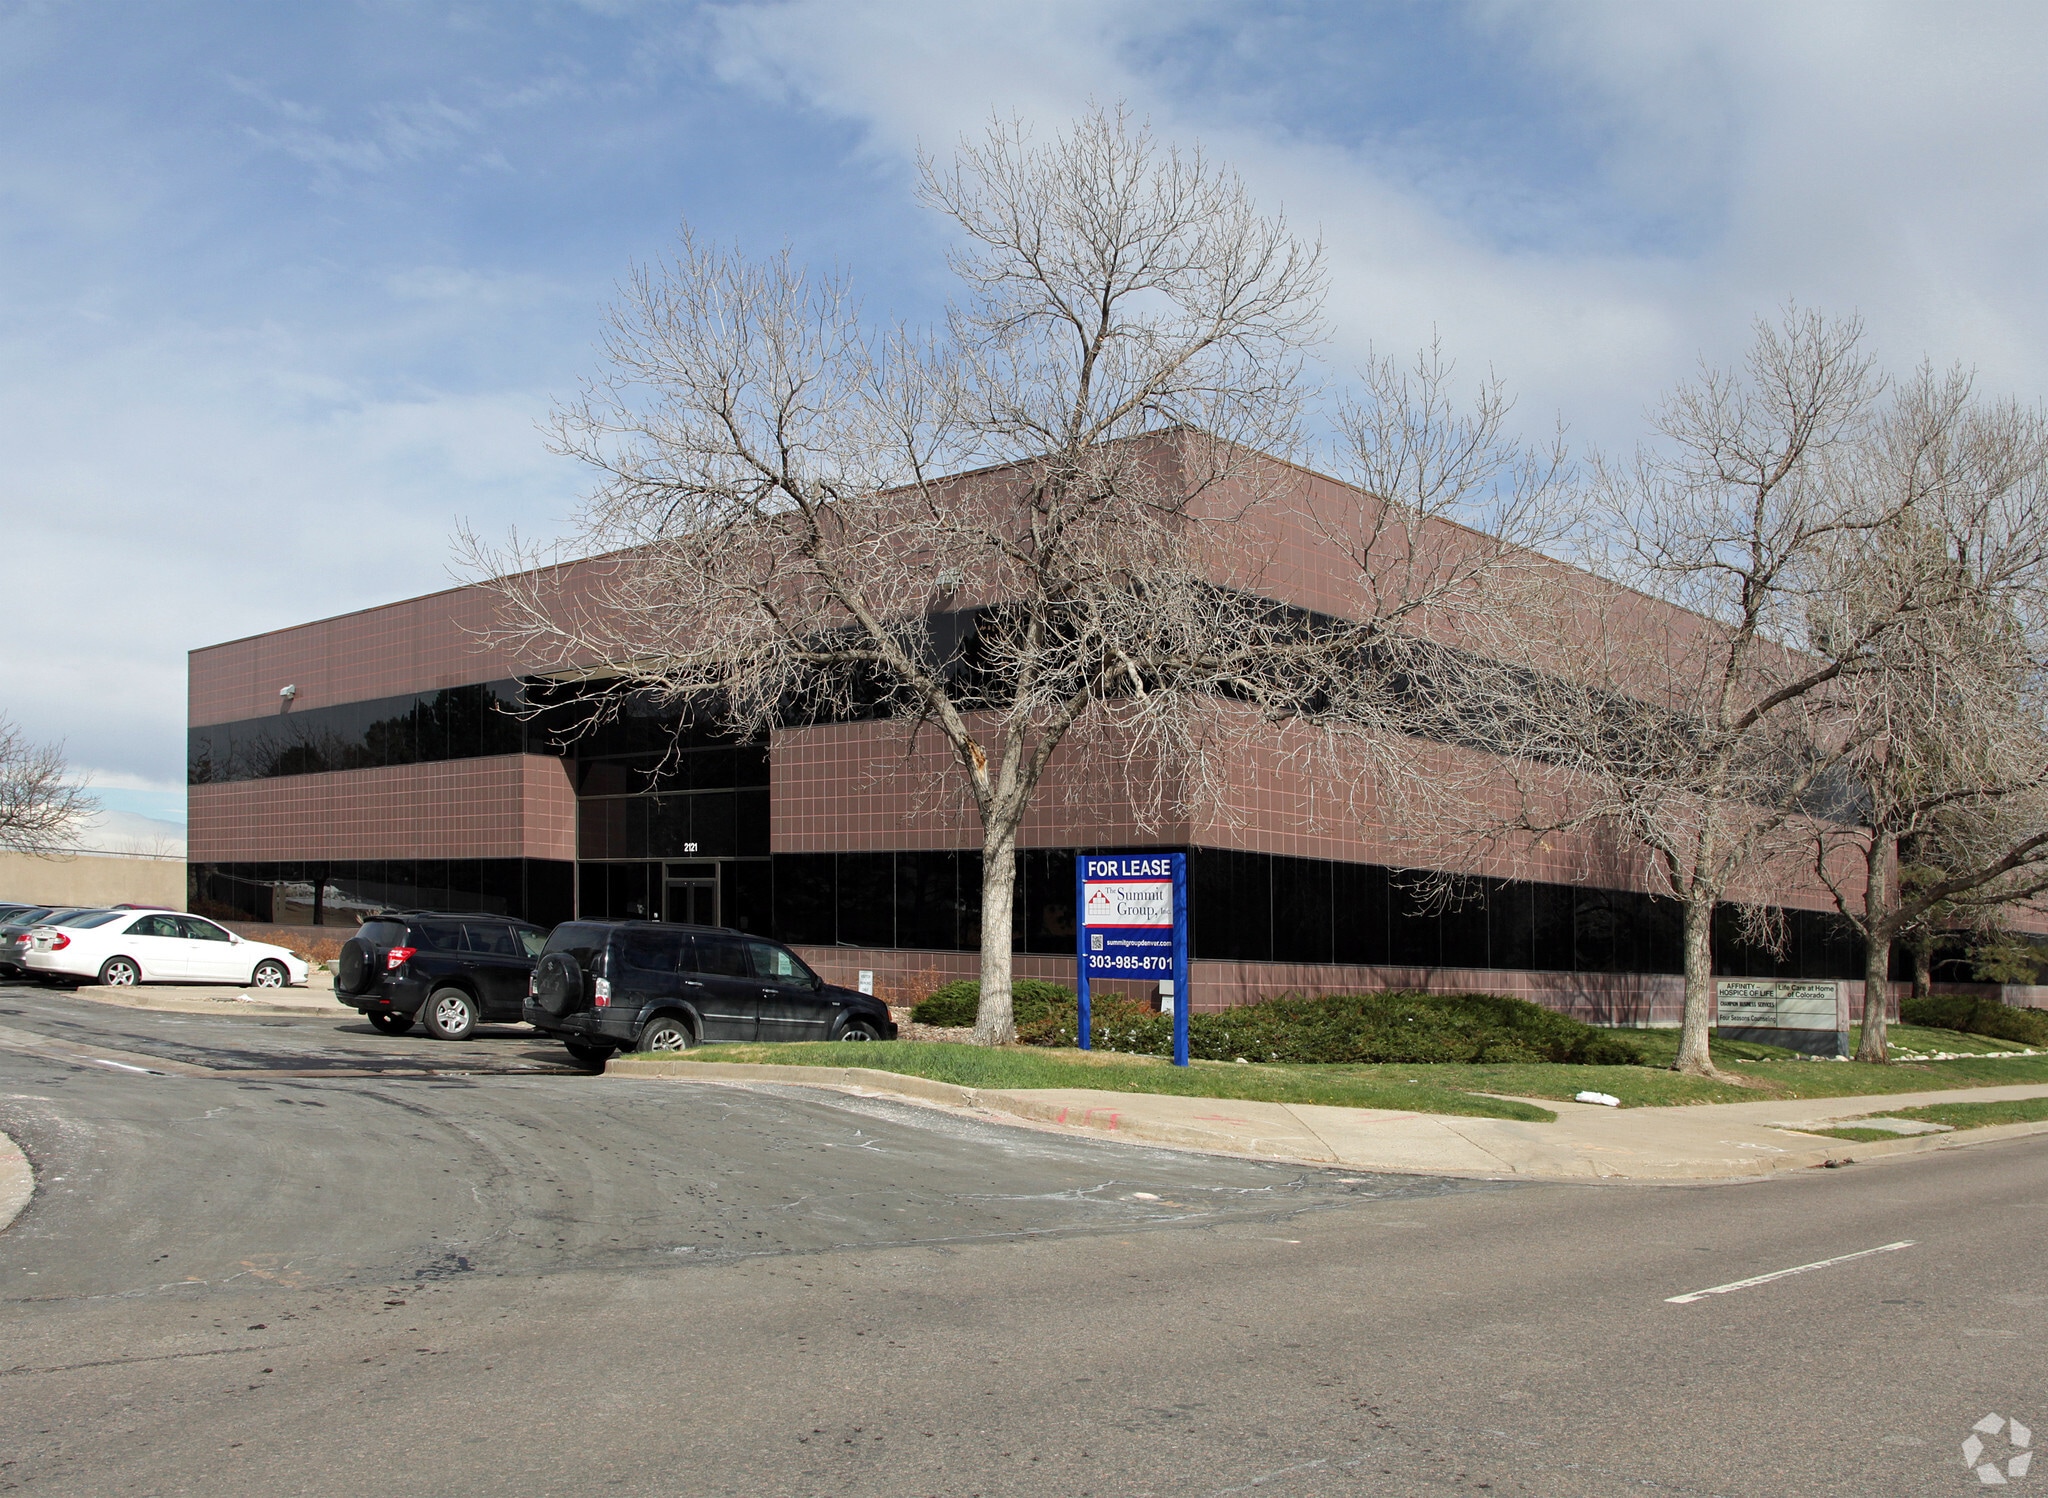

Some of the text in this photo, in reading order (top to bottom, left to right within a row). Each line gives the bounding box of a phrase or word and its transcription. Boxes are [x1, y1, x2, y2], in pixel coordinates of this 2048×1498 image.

[684, 842, 698, 852] 2121
[1088, 859, 1171, 877] FOR LEASE
[1117, 886, 1164, 901] Summit
[1117, 902, 1158, 920] Group,
[1106, 939, 1172, 947] summitgroupdenver.com
[1089, 955, 1173, 970] 303-985-8701
[1795, 991, 1825, 999] Colorado
[1751, 1015, 1776, 1024] Counseling
